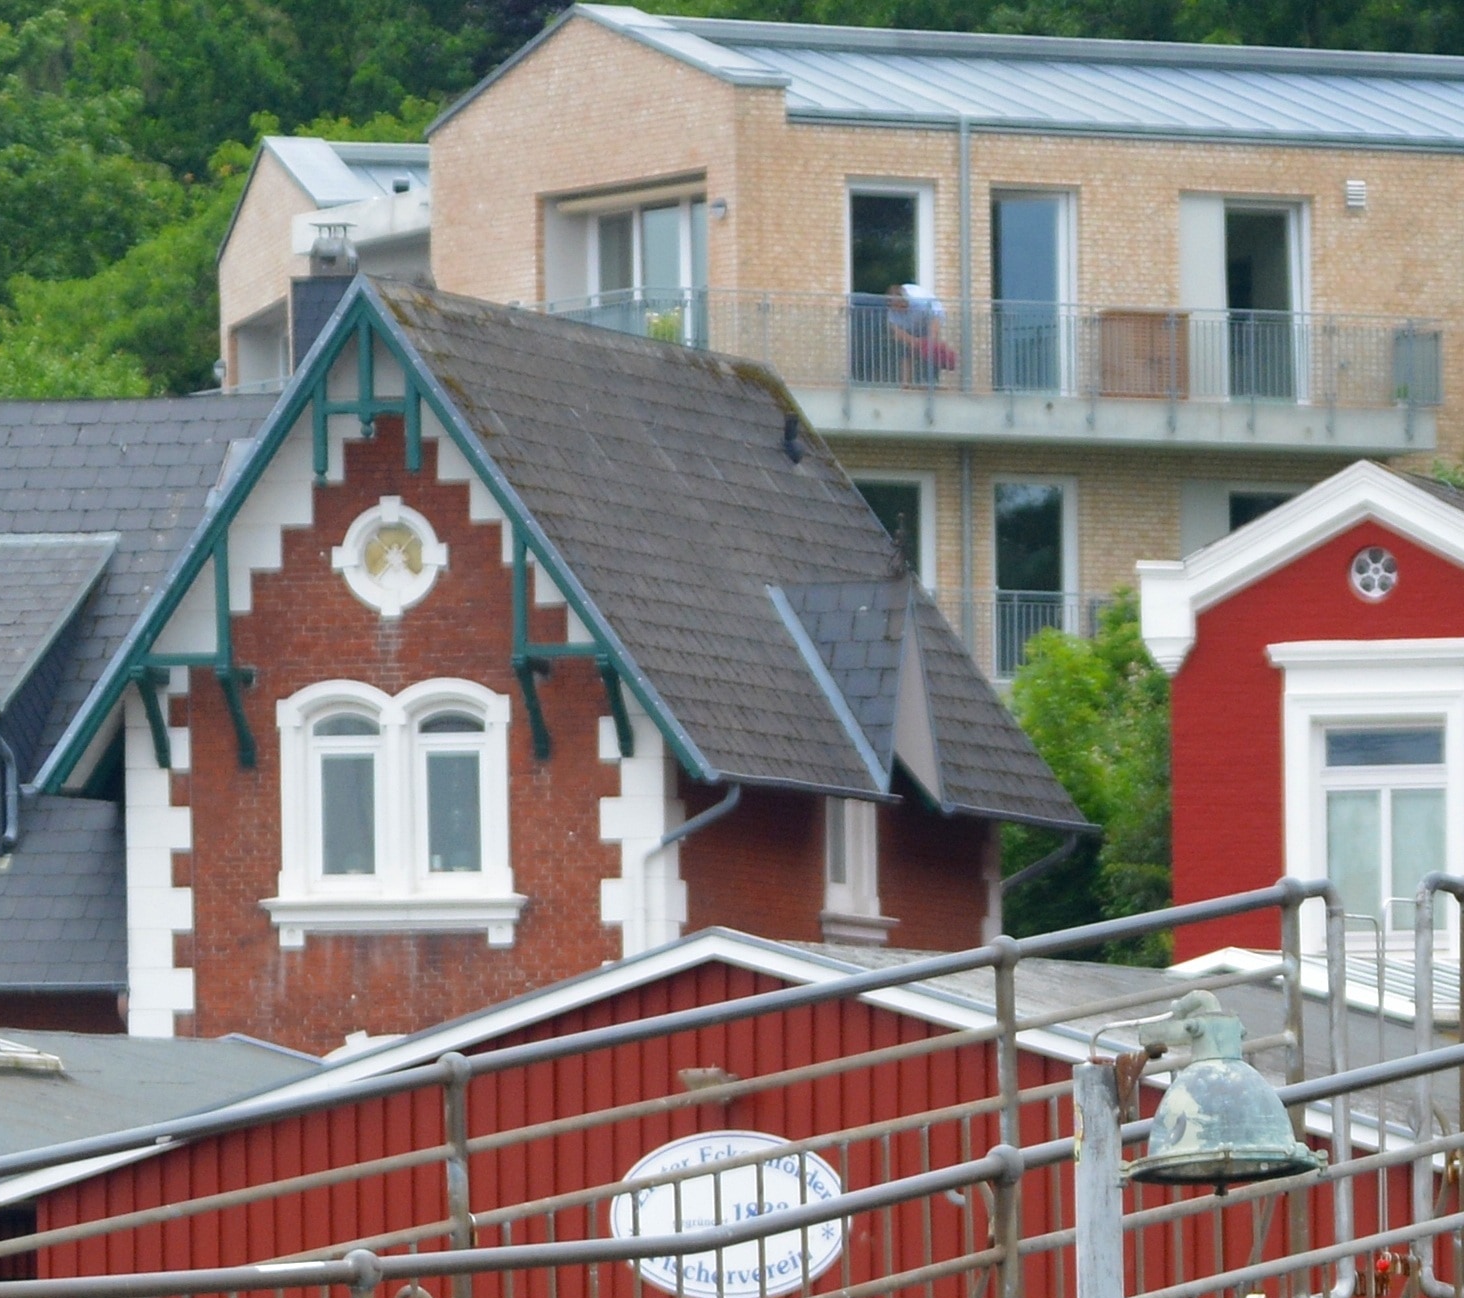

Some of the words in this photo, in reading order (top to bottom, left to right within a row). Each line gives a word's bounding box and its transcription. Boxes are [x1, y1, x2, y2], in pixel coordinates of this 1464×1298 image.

[636, 1158, 690, 1207] Eter
[697, 1144, 832, 1199] Eckförder
[732, 1201, 787, 1221] 18
[648, 1250, 813, 1285] ichrverein
